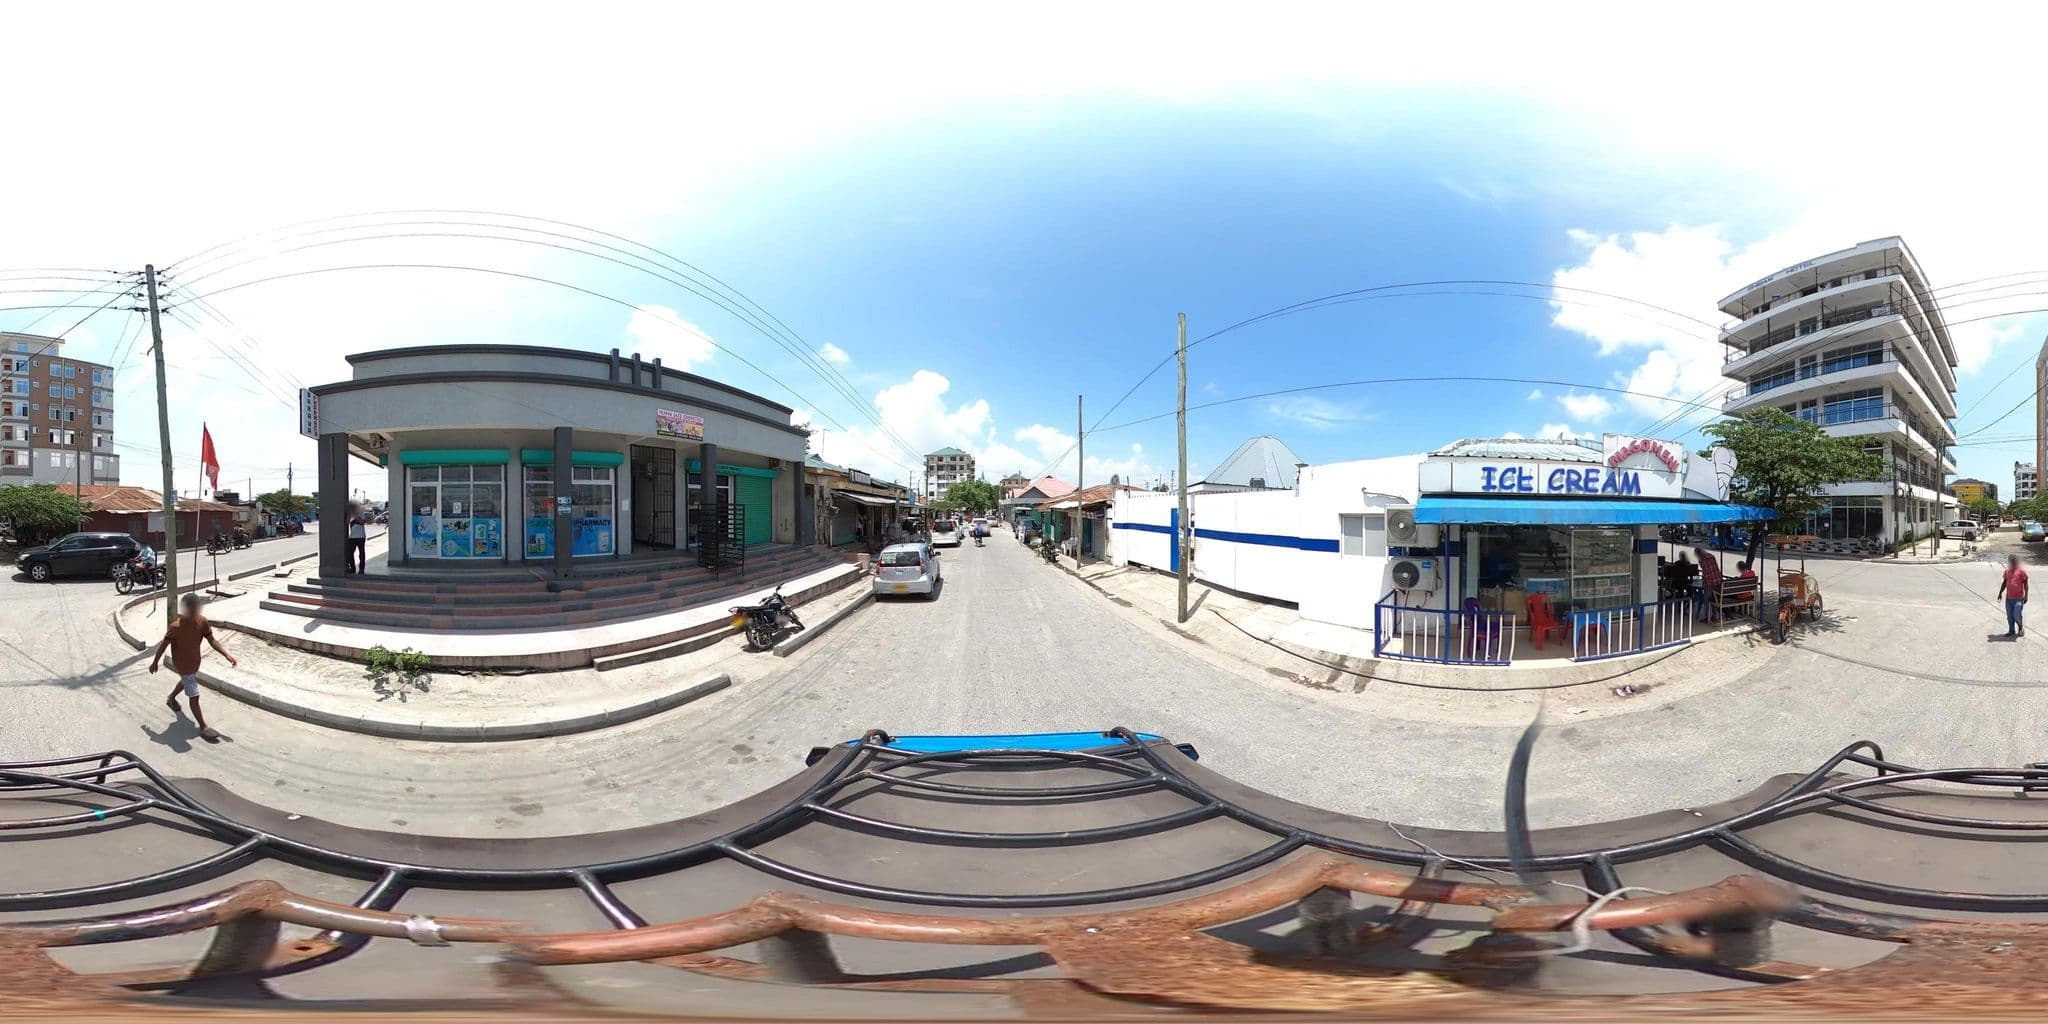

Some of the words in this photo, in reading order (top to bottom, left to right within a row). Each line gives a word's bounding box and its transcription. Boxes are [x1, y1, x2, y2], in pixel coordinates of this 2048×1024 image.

[1786, 260, 1816, 275] HOTEL
[1608, 439, 1680, 472] MAGOMENI
[1481, 466, 1534, 492] ICE
[1548, 468, 1641, 495] CREAM
[576, 519, 611, 527] PHARMACY
